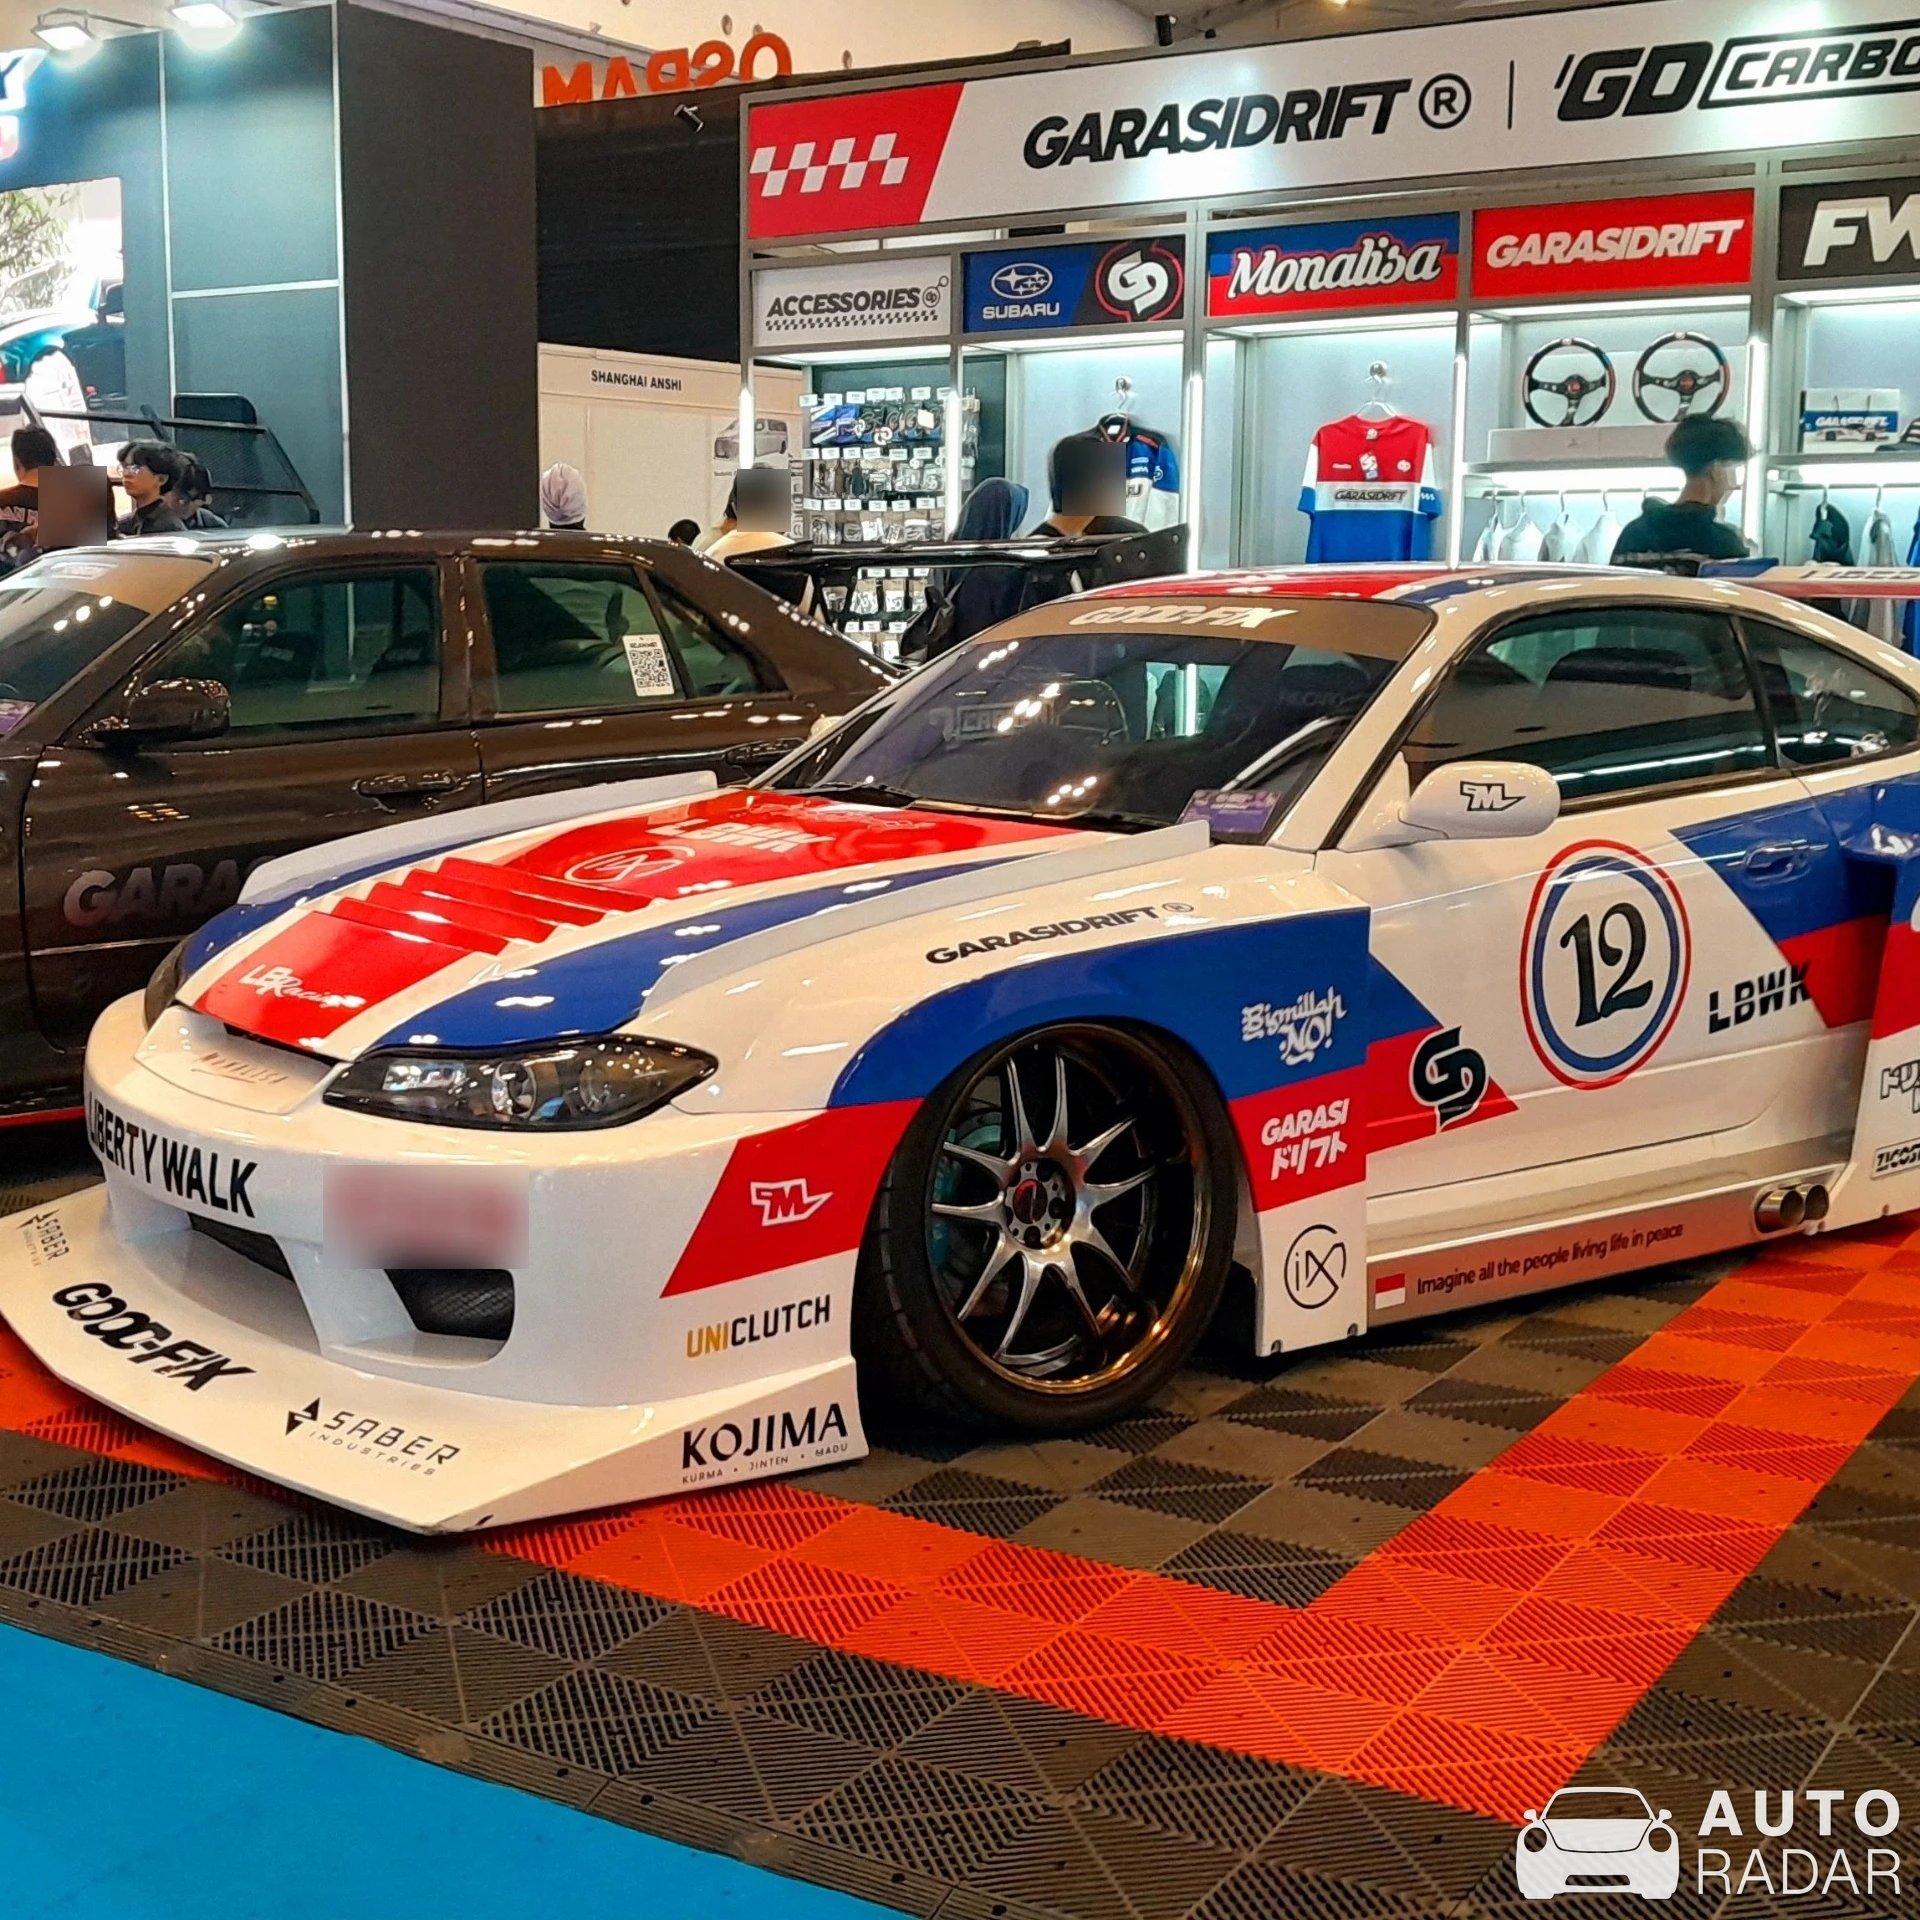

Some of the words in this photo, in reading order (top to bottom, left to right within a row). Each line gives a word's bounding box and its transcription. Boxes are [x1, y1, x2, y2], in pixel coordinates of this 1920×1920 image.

[1023, 77, 1413, 169] GARASIDRIFT
[1226, 235, 1443, 300] Monalisa
[1486, 219, 1745, 268] GARASIDRIFT
[767, 286, 921, 318] ACCESSORIES
[982, 302, 1061, 320] SUBARU
[591, 369, 648, 387] SHANGHAI
[650, 376, 682, 391] ANSHI
[1334, 488, 1408, 502] GARASIDRIFT
[63, 855, 277, 928] GARA
[925, 906, 1160, 965] GARASIDRIFT
[1560, 902, 1654, 1027] 12
[1241, 985, 1347, 1042] Bismillah
[1708, 960, 1812, 1035] LBWK
[1260, 1097, 1350, 1146] GARASI
[87, 1091, 158, 1184] LIBERTY
[162, 1136, 258, 1219] WALK
[1270, 1130, 1348, 1181] ドリフト
[1417, 1268, 1476, 1294] Imagine
[1479, 1261, 1495, 1281] all
[1497, 1258, 1520, 1277] the
[1523, 1246, 1569, 1276] people
[1572, 1239, 1607, 1259] living
[1610, 1232, 1630, 1252] life
[1631, 1229, 1644, 1247] in
[1646, 1223, 1683, 1248] peace
[686, 1294, 831, 1360] UNICLUTCH
[309, 1431, 436, 1476] INDUSTRIES
[323, 1411, 461, 1465] SABER
[682, 1402, 848, 1470] KOJIMA
[682, 1468, 723, 1485] KURMA
[749, 1456, 789, 1472] JINTEN
[815, 1443, 848, 1457] MADU
